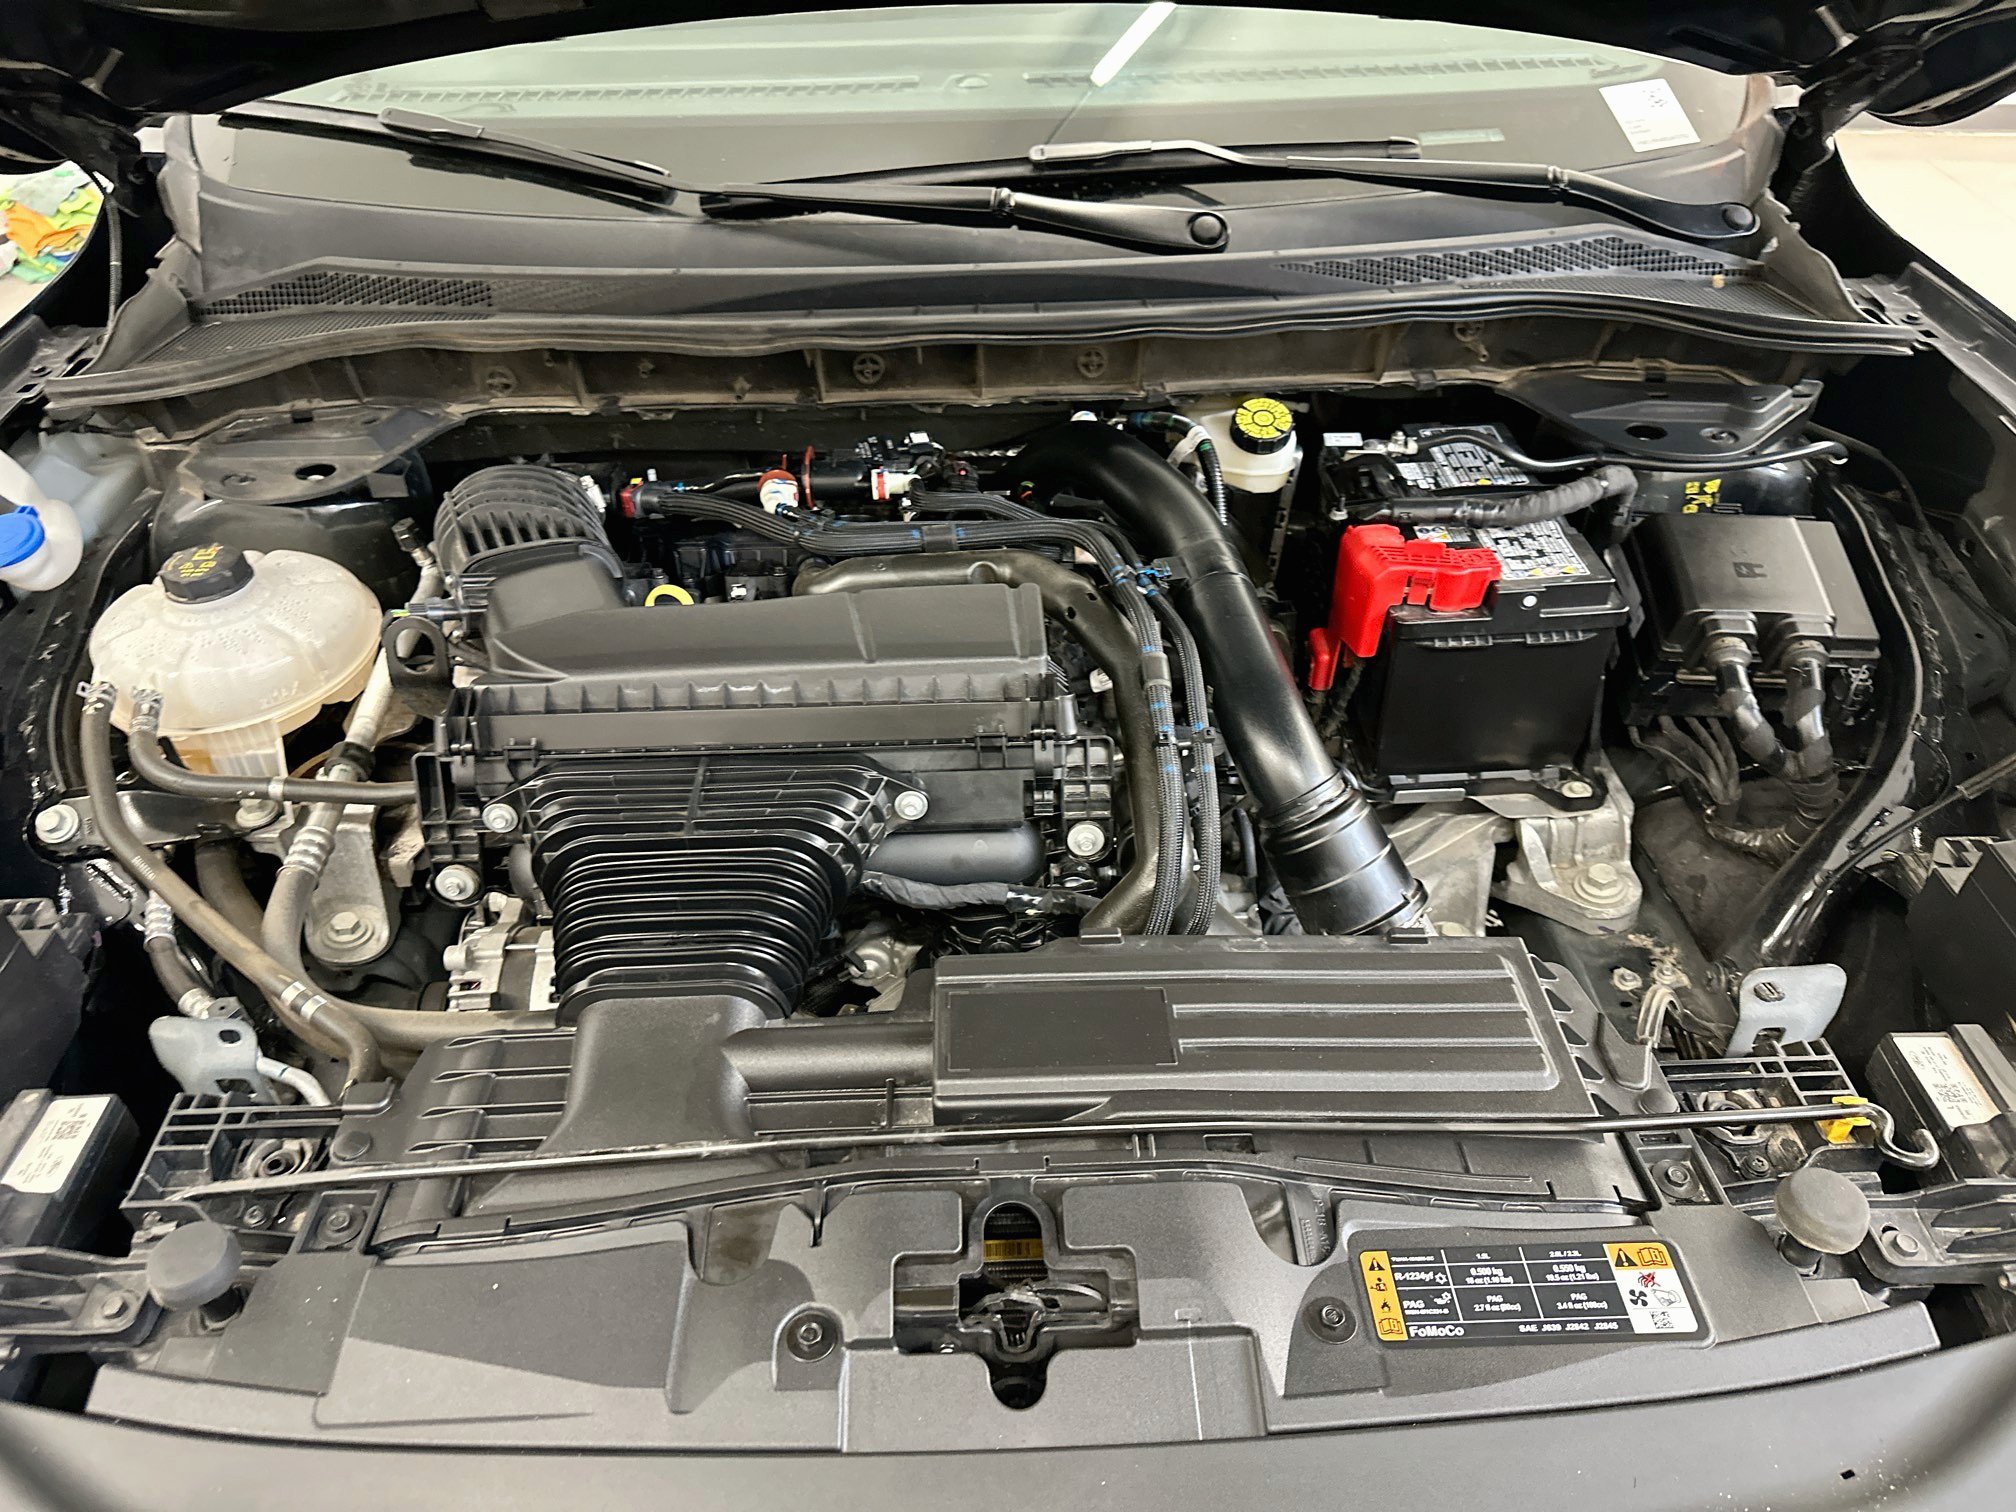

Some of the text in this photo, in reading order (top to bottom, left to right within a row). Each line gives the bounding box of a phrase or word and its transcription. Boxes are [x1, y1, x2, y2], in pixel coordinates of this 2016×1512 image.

[1486, 1294, 1504, 1303] PAG
[1570, 1292, 1588, 1301] PAG
[1402, 1299, 1425, 1309] PAG
[1408, 1324, 1465, 1338] FoMoCo
[1518, 1324, 1539, 1333] SAE
[1565, 1322, 1590, 1331] J2842
[1593, 1321, 1619, 1330] J2845
